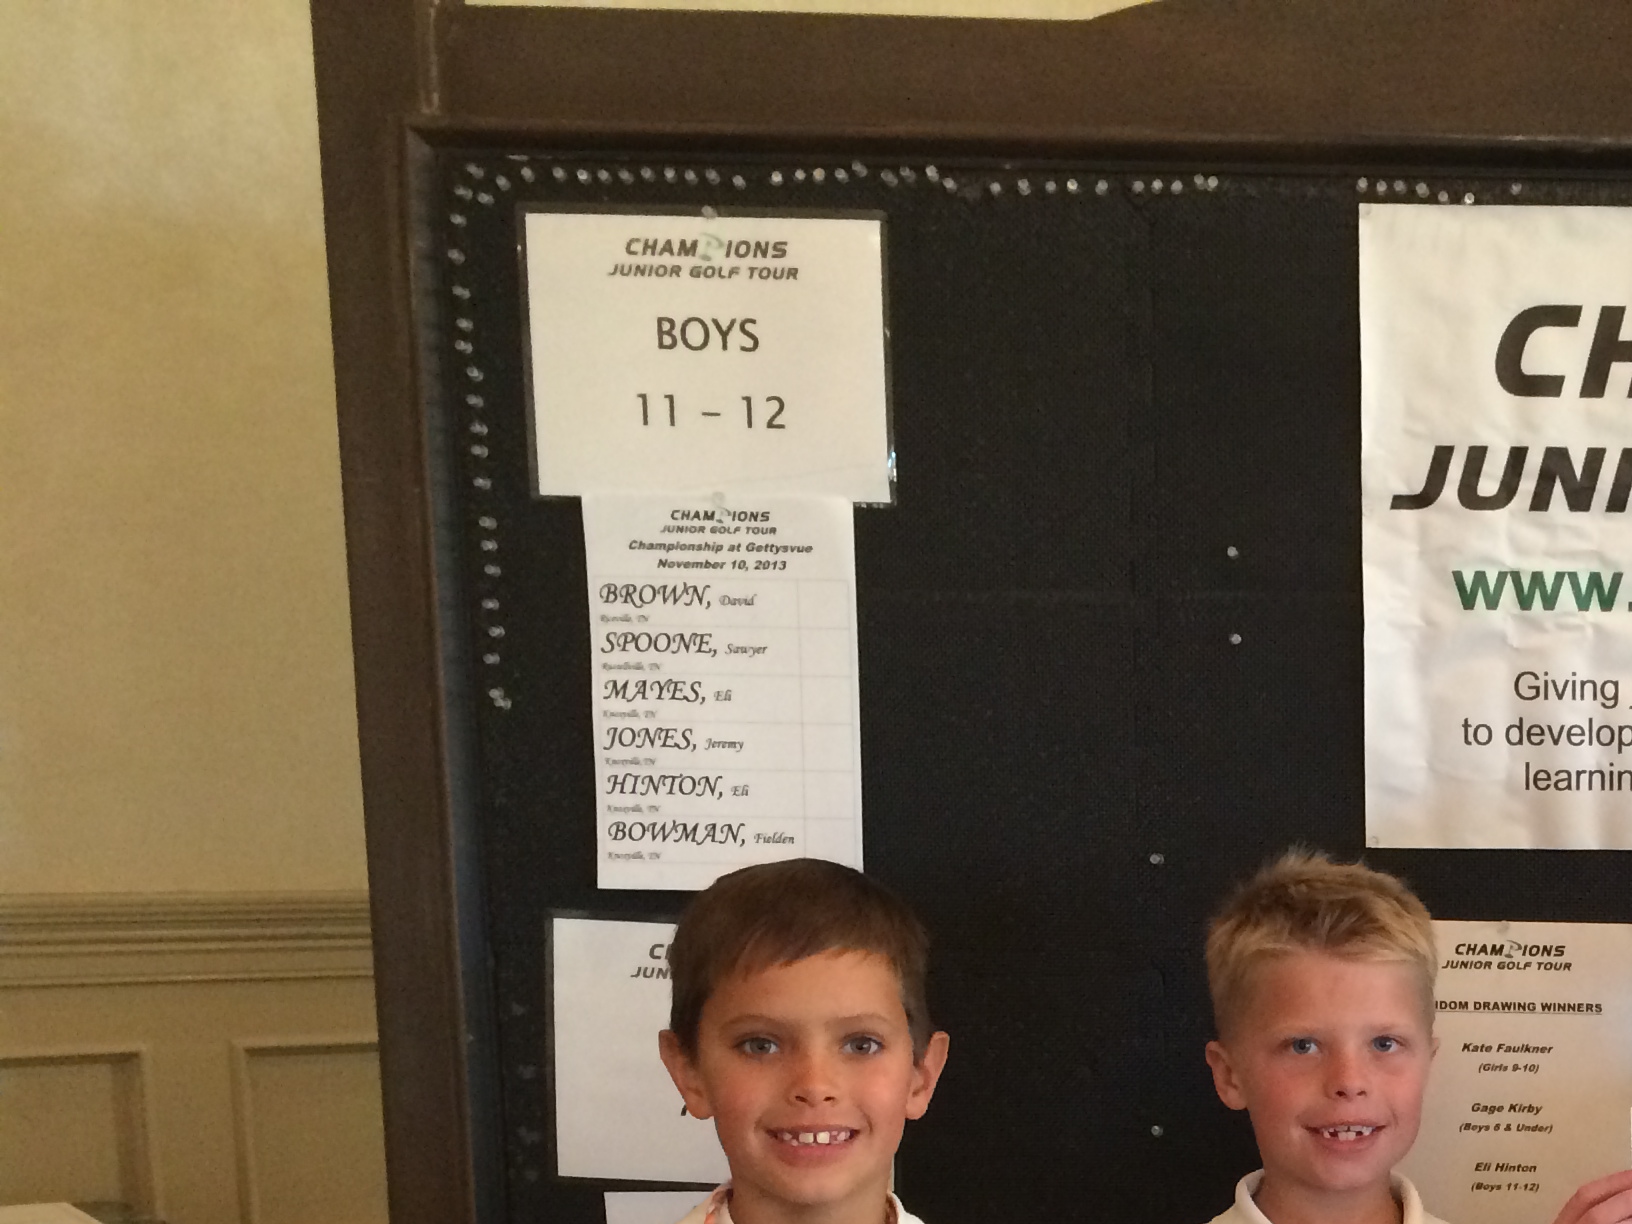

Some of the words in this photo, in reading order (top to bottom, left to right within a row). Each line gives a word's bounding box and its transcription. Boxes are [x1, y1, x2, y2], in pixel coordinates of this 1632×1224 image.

[624, 232, 788, 261] CHAMPIONS
[608, 263, 681, 280] JUNIOR
[689, 265, 740, 280] GOLF
[747, 265, 799, 281] TOUR
[656, 316, 760, 353] BOYS
[635, 394, 677, 426] 11
[741, 396, 787, 429] 12
[671, 506, 770, 523] CHAMPIONS
[660, 525, 706, 535] JUNIOR
[710, 526, 740, 535] GOLF
[746, 526, 777, 535] TOUR
[628, 540, 723, 553] Championship
[727, 542, 741, 552] at
[746, 542, 813, 554] Gettysvue
[657, 559, 726, 570] November
[731, 560, 749, 571] 10,
[754, 560, 787, 570] 2013
[599, 582, 711, 609] BROWN,
[719, 594, 757, 606] David
[601, 632, 717, 657] SPOONE,
[725, 644, 768, 657] Sawyer
[603, 679, 705, 705] MAYES,
[714, 690, 732, 701] Eli
[1513, 669, 1619, 709] Giving
[603, 727, 697, 752] JONES,
[704, 738, 744, 752] Jeremy
[1461, 717, 1494, 747] to
[606, 773, 723, 800] HINTON,
[731, 785, 749, 797] Eli
[608, 820, 746, 847] BOWMAN,
[754, 833, 794, 844] Fielden
[1455, 940, 1566, 959] CHAMPIONS
[1441, 960, 1492, 970] JUNIOR
[1496, 961, 1532, 971] GOLF
[1536, 961, 1572, 971] TOUR
[1473, 1002, 1536, 1013] DRAWING
[1540, 1003, 1603, 1014] WINNERS
[1461, 1042, 1493, 1054] Kate
[1496, 1043, 1553, 1054] Faulkner
[1478, 1062, 1508, 1074] (Girls
[1511, 1062, 1539, 1074] 9-10)
[1471, 1103, 1504, 1115] Gage
[1507, 1103, 1543, 1116] Kirby
[1459, 1122, 1490, 1133] (Boys
[1504, 1123, 1512, 1131] &
[1516, 1123, 1553, 1134] Under)
[1474, 1162, 1492, 1172] Eli
[1494, 1162, 1537, 1172] Hinton
[1471, 1182, 1502, 1192] (Boys
[1506, 1183, 1540, 1193] 11-12)
